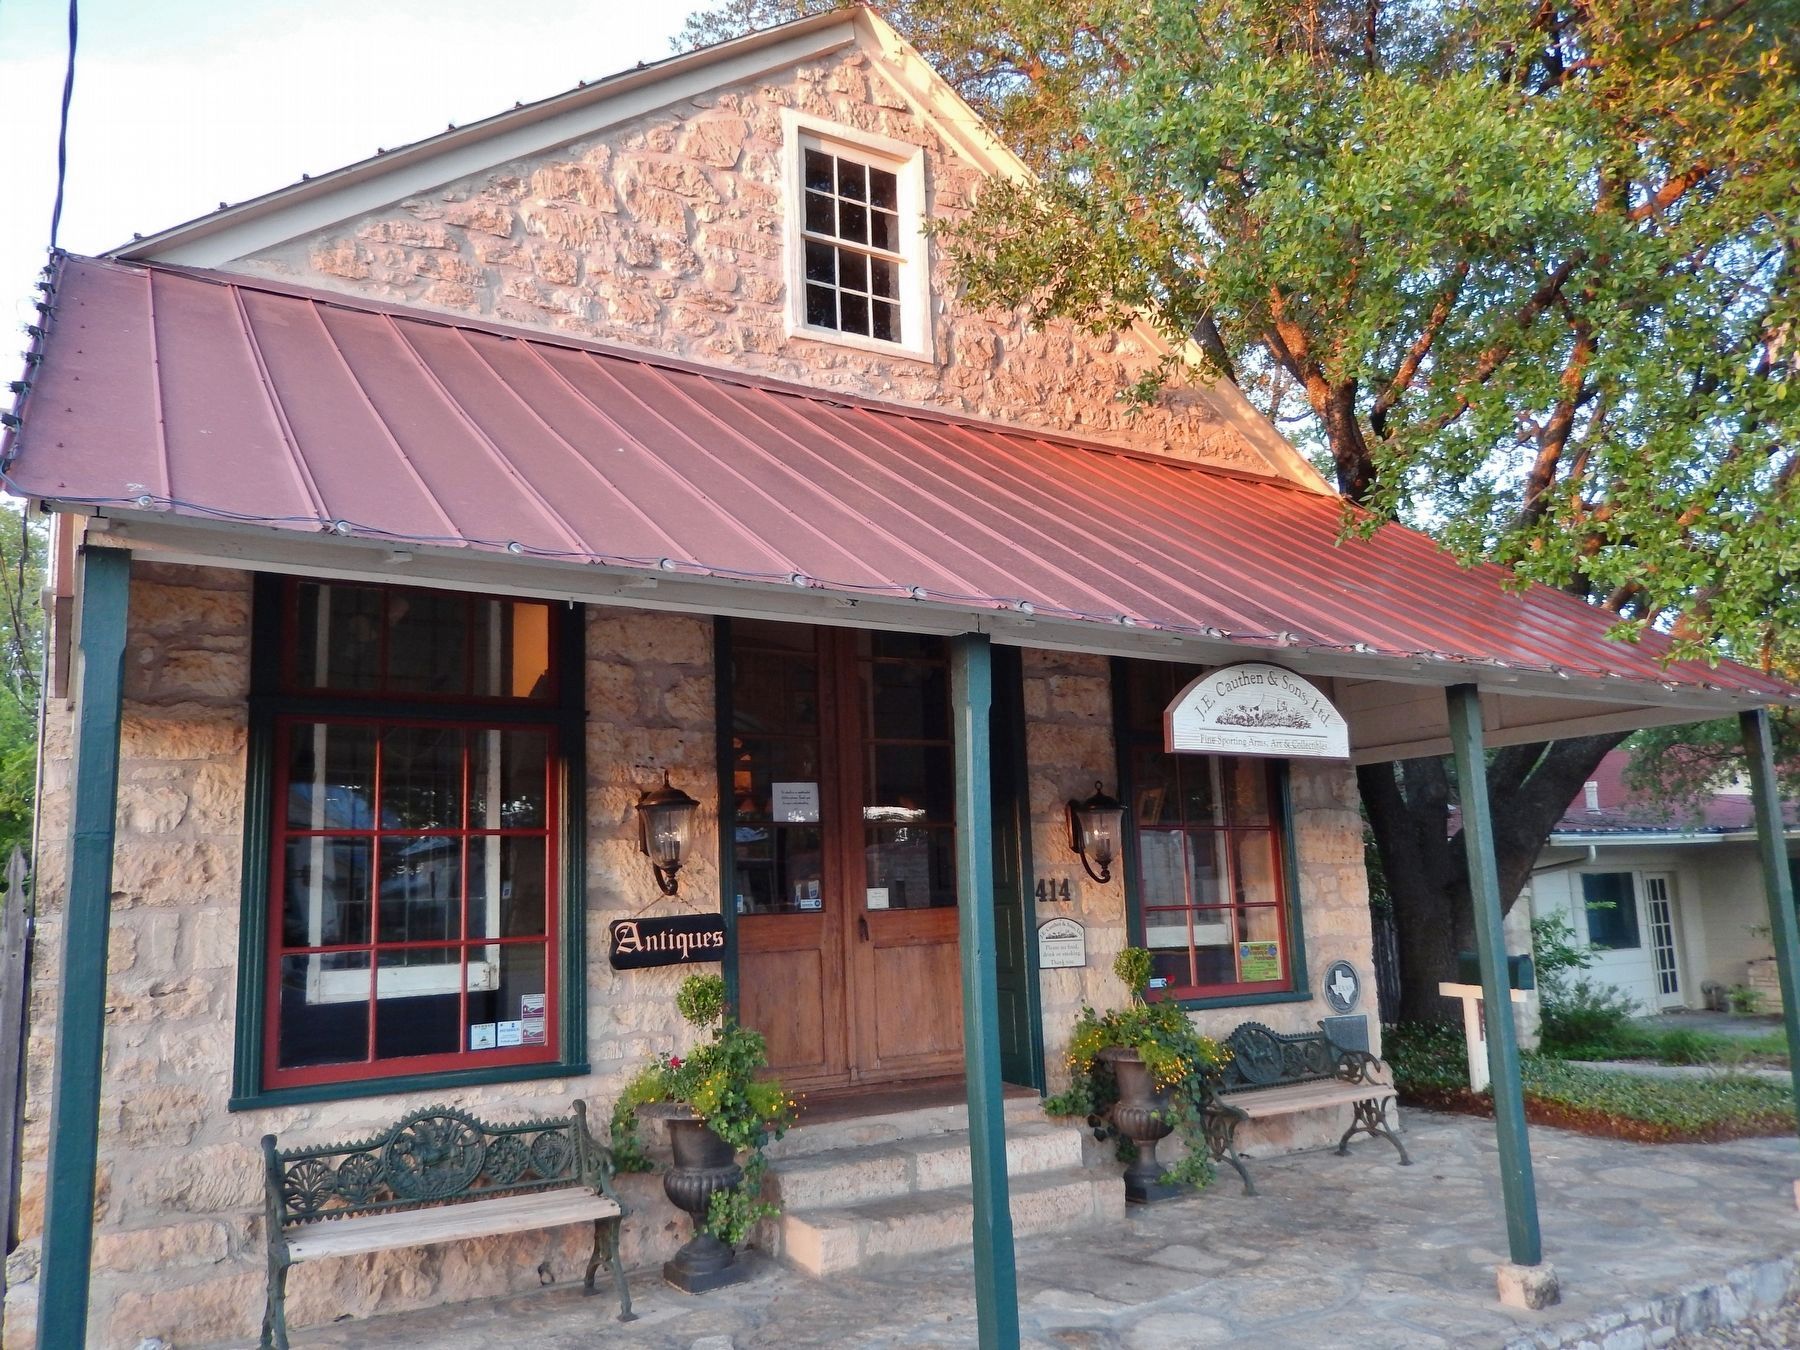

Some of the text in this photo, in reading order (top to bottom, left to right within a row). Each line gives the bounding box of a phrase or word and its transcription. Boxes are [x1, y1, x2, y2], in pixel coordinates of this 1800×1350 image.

[1194, 670, 1331, 728] J.E. Cauthen & Sons, Ltd.
[1200, 733, 1216, 746] Fine
[1217, 734, 1247, 748] Sporting
[1271, 738, 1283, 749] Art
[1290, 739, 1328, 751] Collectibles
[1035, 878, 1071, 902] 414
[614, 921, 724, 960] Antiques
